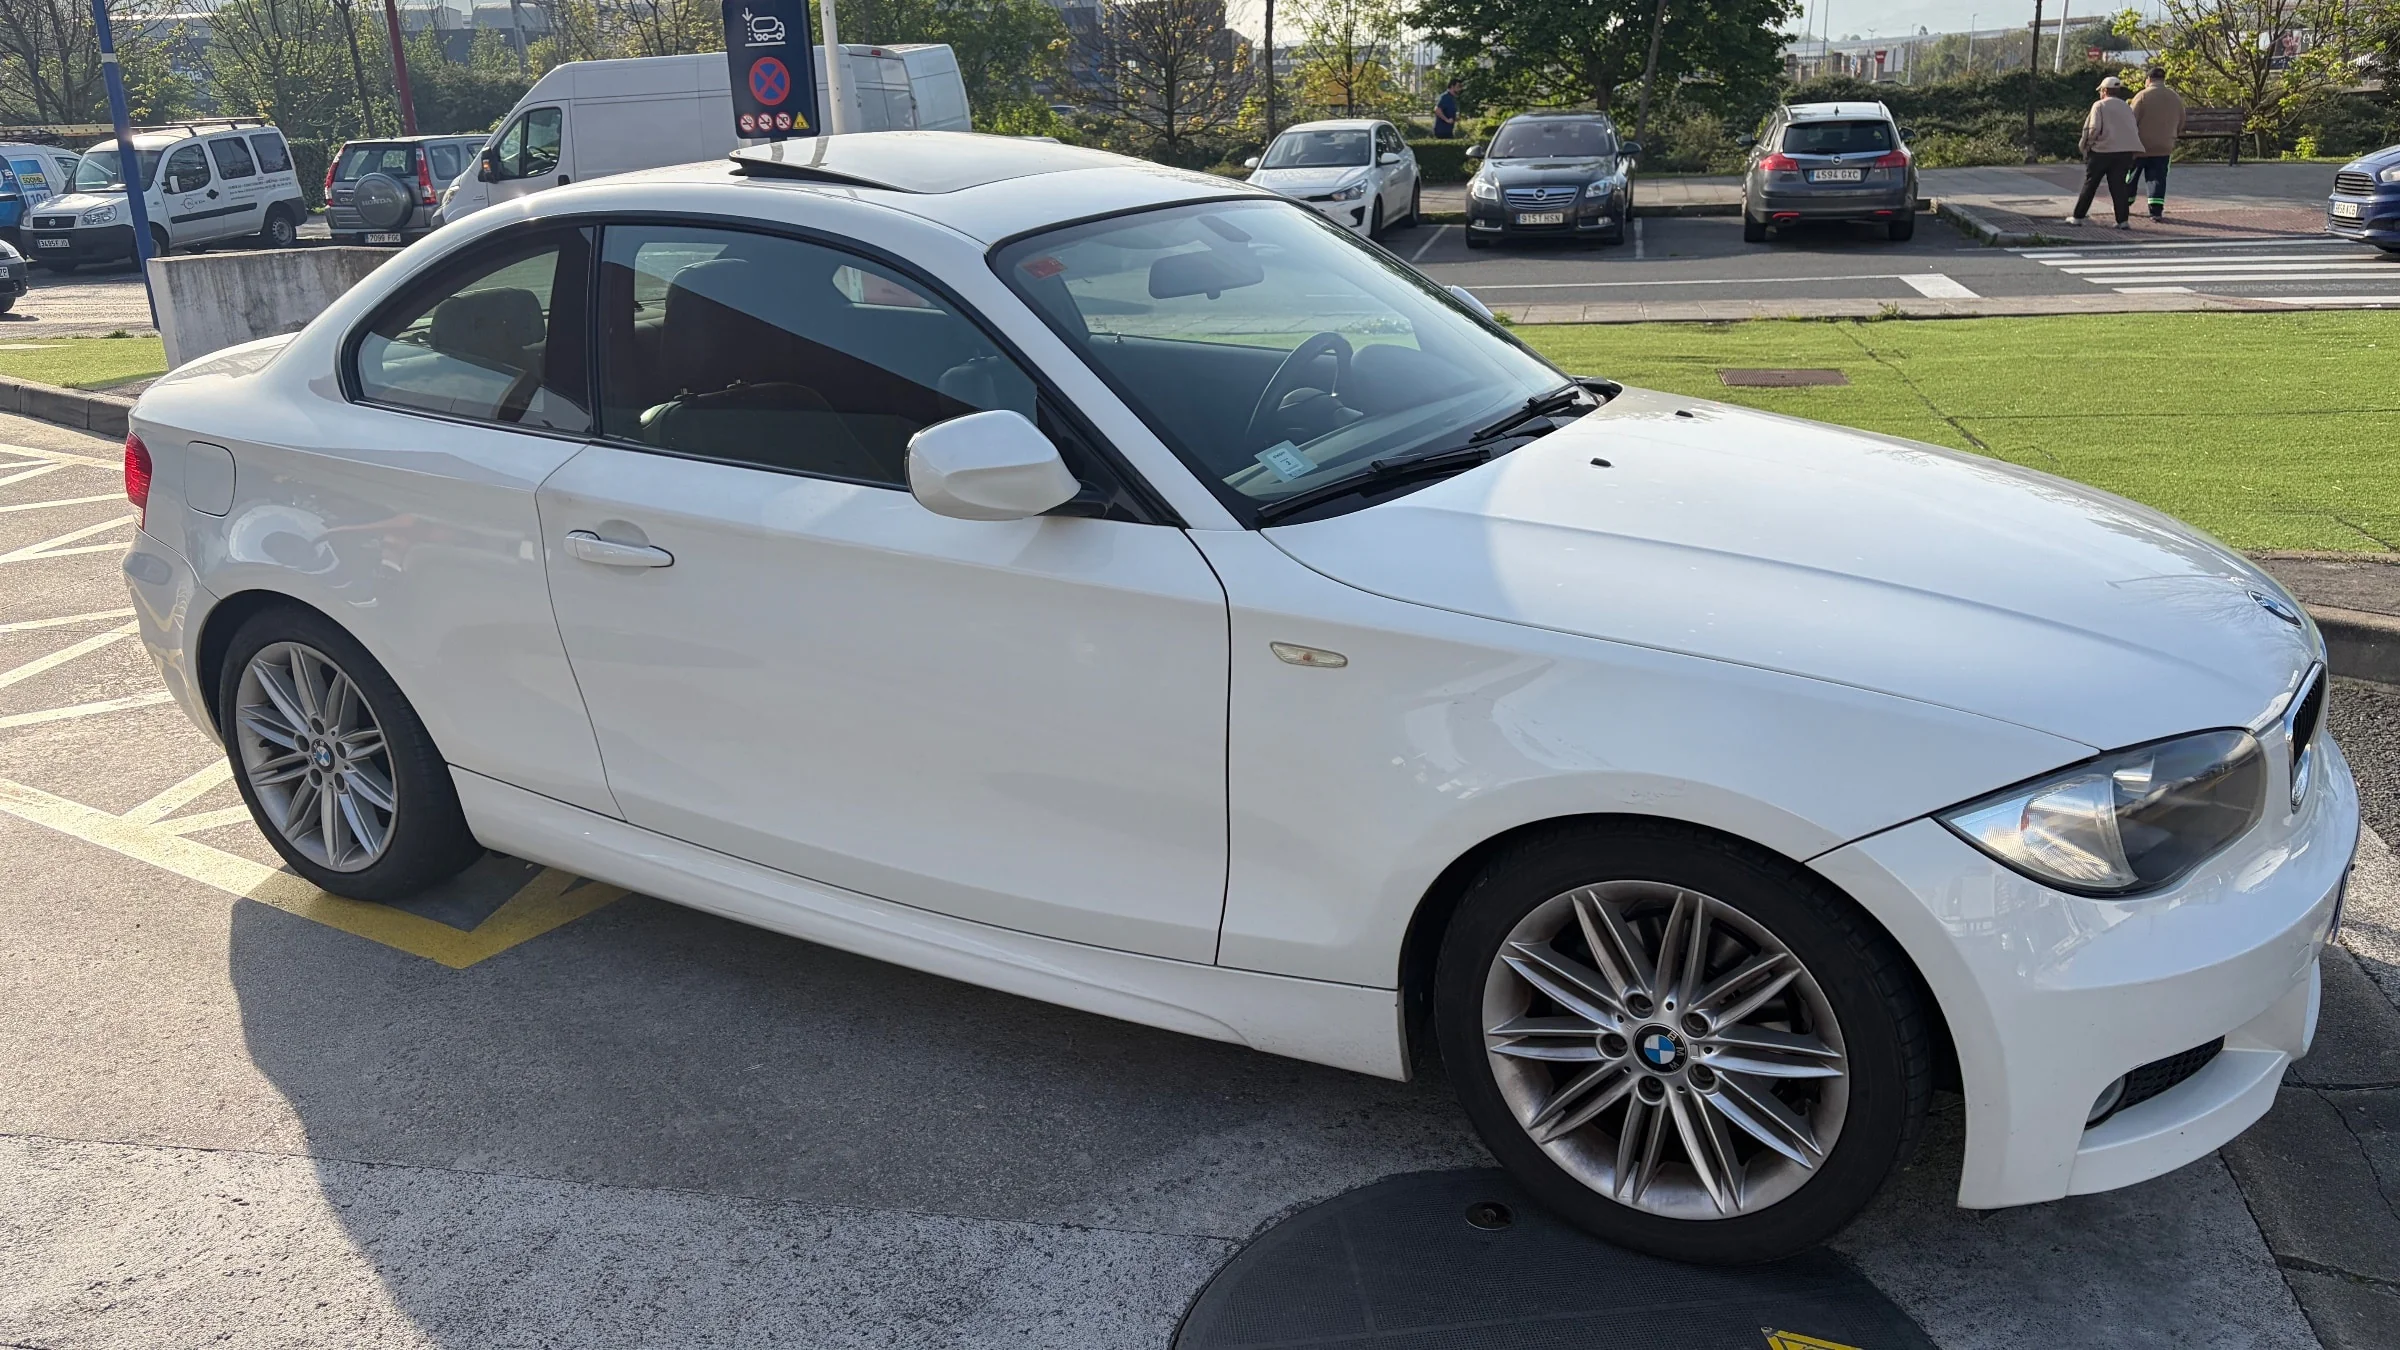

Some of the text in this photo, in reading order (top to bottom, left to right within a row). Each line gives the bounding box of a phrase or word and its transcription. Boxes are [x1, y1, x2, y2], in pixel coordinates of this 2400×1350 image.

[1815, 170, 1859, 179] 4594 GXC
[361, 197, 393, 206] HONDA
[1543, 214, 1561, 223] HSN
